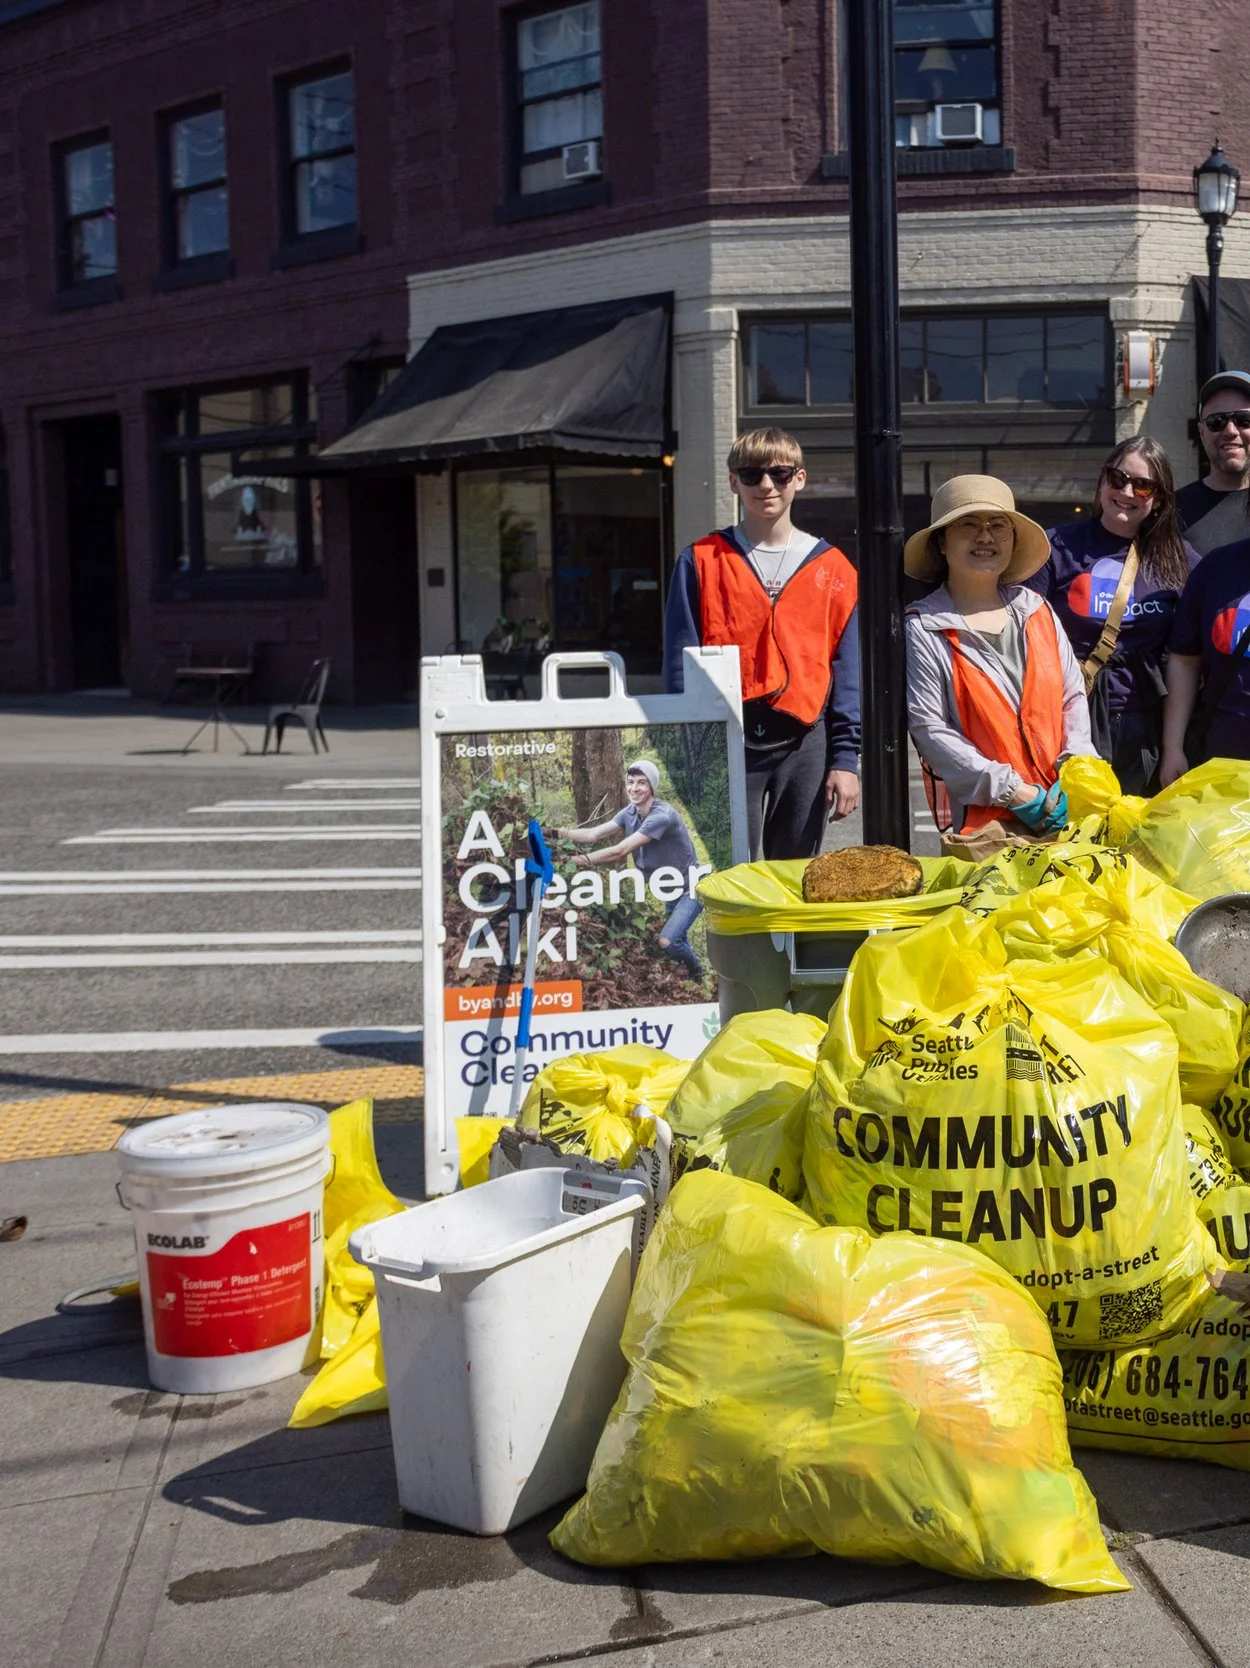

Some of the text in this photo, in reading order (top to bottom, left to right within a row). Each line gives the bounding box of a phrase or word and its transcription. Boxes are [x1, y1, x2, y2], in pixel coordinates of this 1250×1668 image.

[455, 740, 557, 758] Restorative
[456, 810, 506, 860] A
[458, 858, 712, 913] Cleaner
[458, 909, 578, 968] Alki
[461, 1018, 674, 1058] Community
[461, 1057, 547, 1088] Clea
[833, 1094, 1132, 1170] COMMUNITY
[866, 1177, 1118, 1243] CLEANUP
[230, 1274, 260, 1287] Phase
[271, 1257, 307, 1279] Detergent
